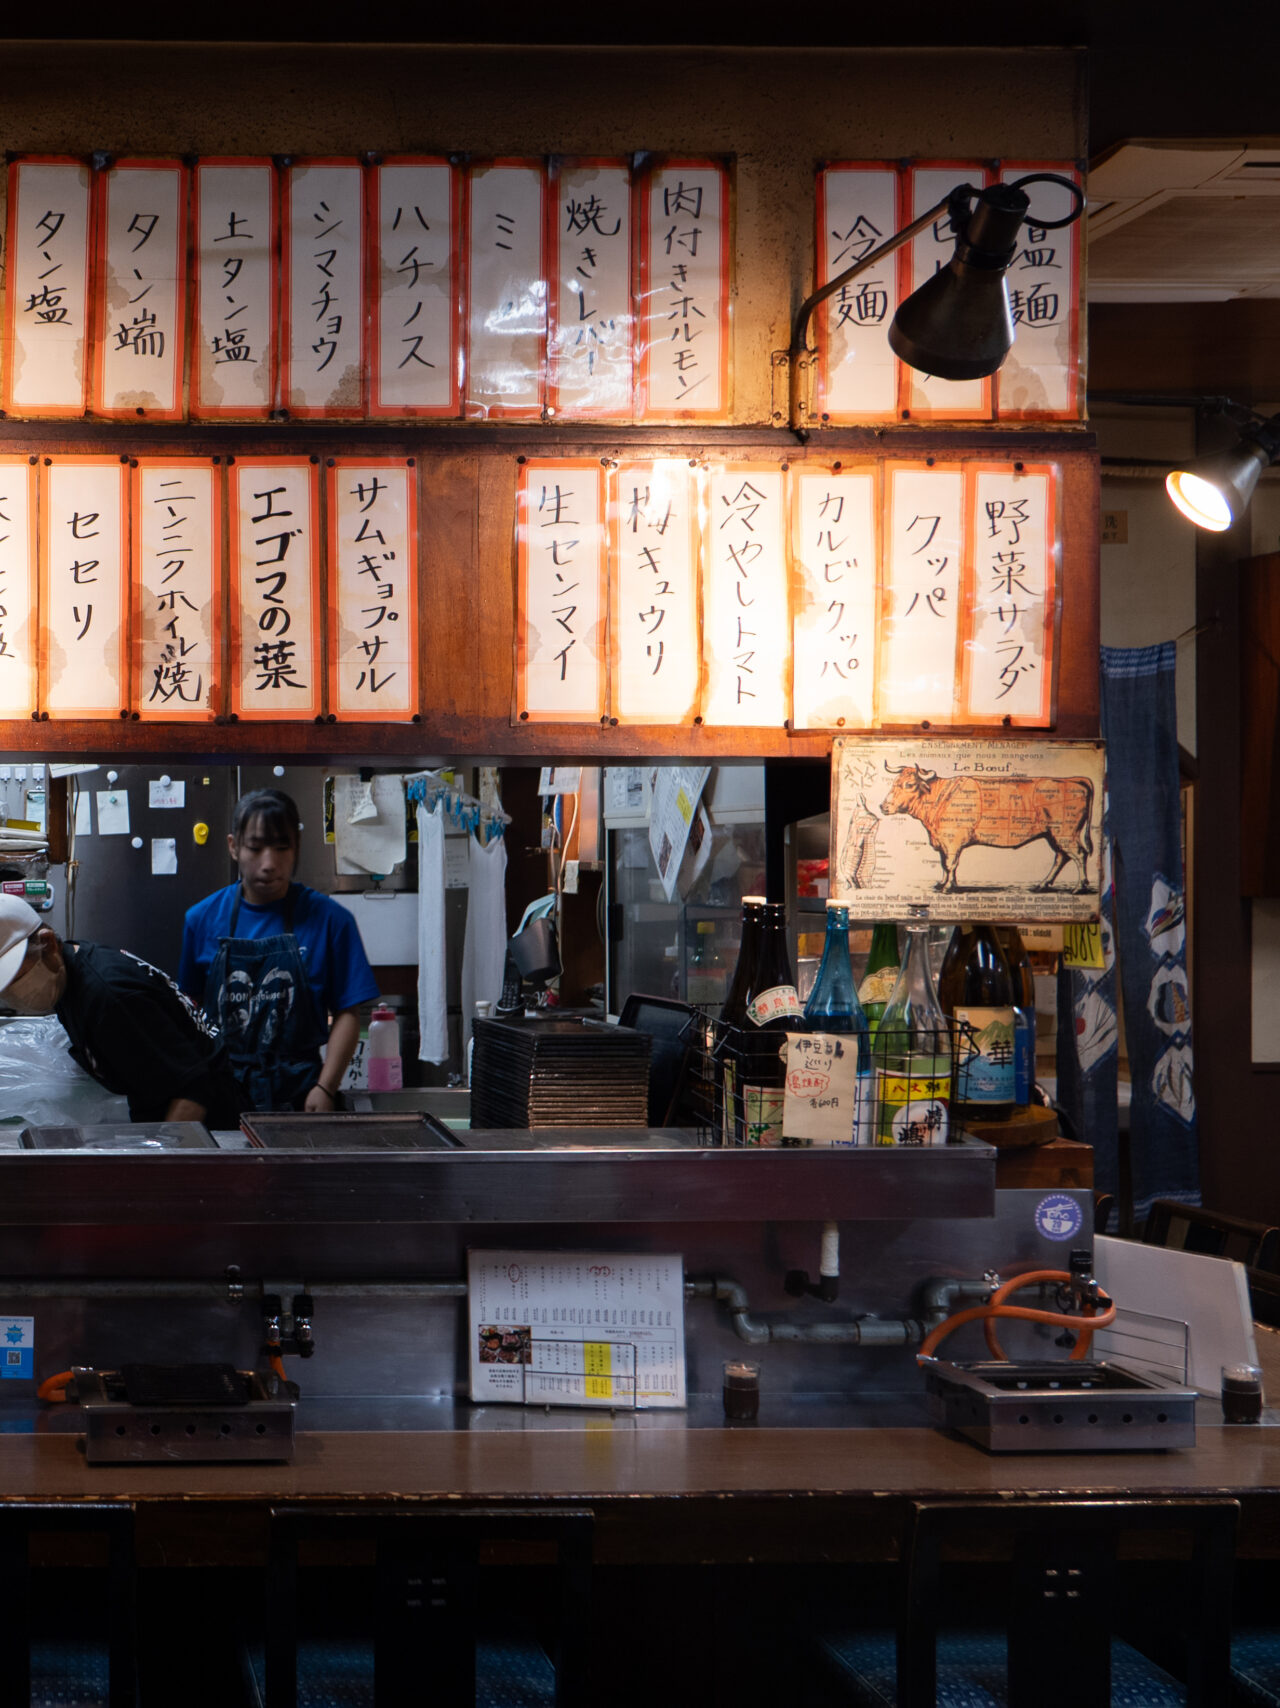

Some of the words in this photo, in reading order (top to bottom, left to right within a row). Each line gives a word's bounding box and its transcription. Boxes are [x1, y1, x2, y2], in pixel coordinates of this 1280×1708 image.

[24, 210, 72, 325] タン塩
[211, 212, 257, 364] 上タン塩
[312, 201, 342, 372] シマチョウ
[392, 207, 435, 369] ハチノス
[567, 195, 621, 376] 焼きレバー
[664, 181, 710, 400] 肉付きホルモン
[66, 511, 100, 641] セセリ
[251, 487, 307, 691] エゴマの葉
[349, 477, 399, 693] サムギョプサル
[538, 485, 580, 681] 生センマイ
[720, 481, 767, 705] 冷やしトマト
[817, 492, 859, 680] カルビクッパ
[904, 514, 949, 619] クッパ
[985, 499, 1042, 701] 野菜サラダ
[953, 763, 971, 771] Le
